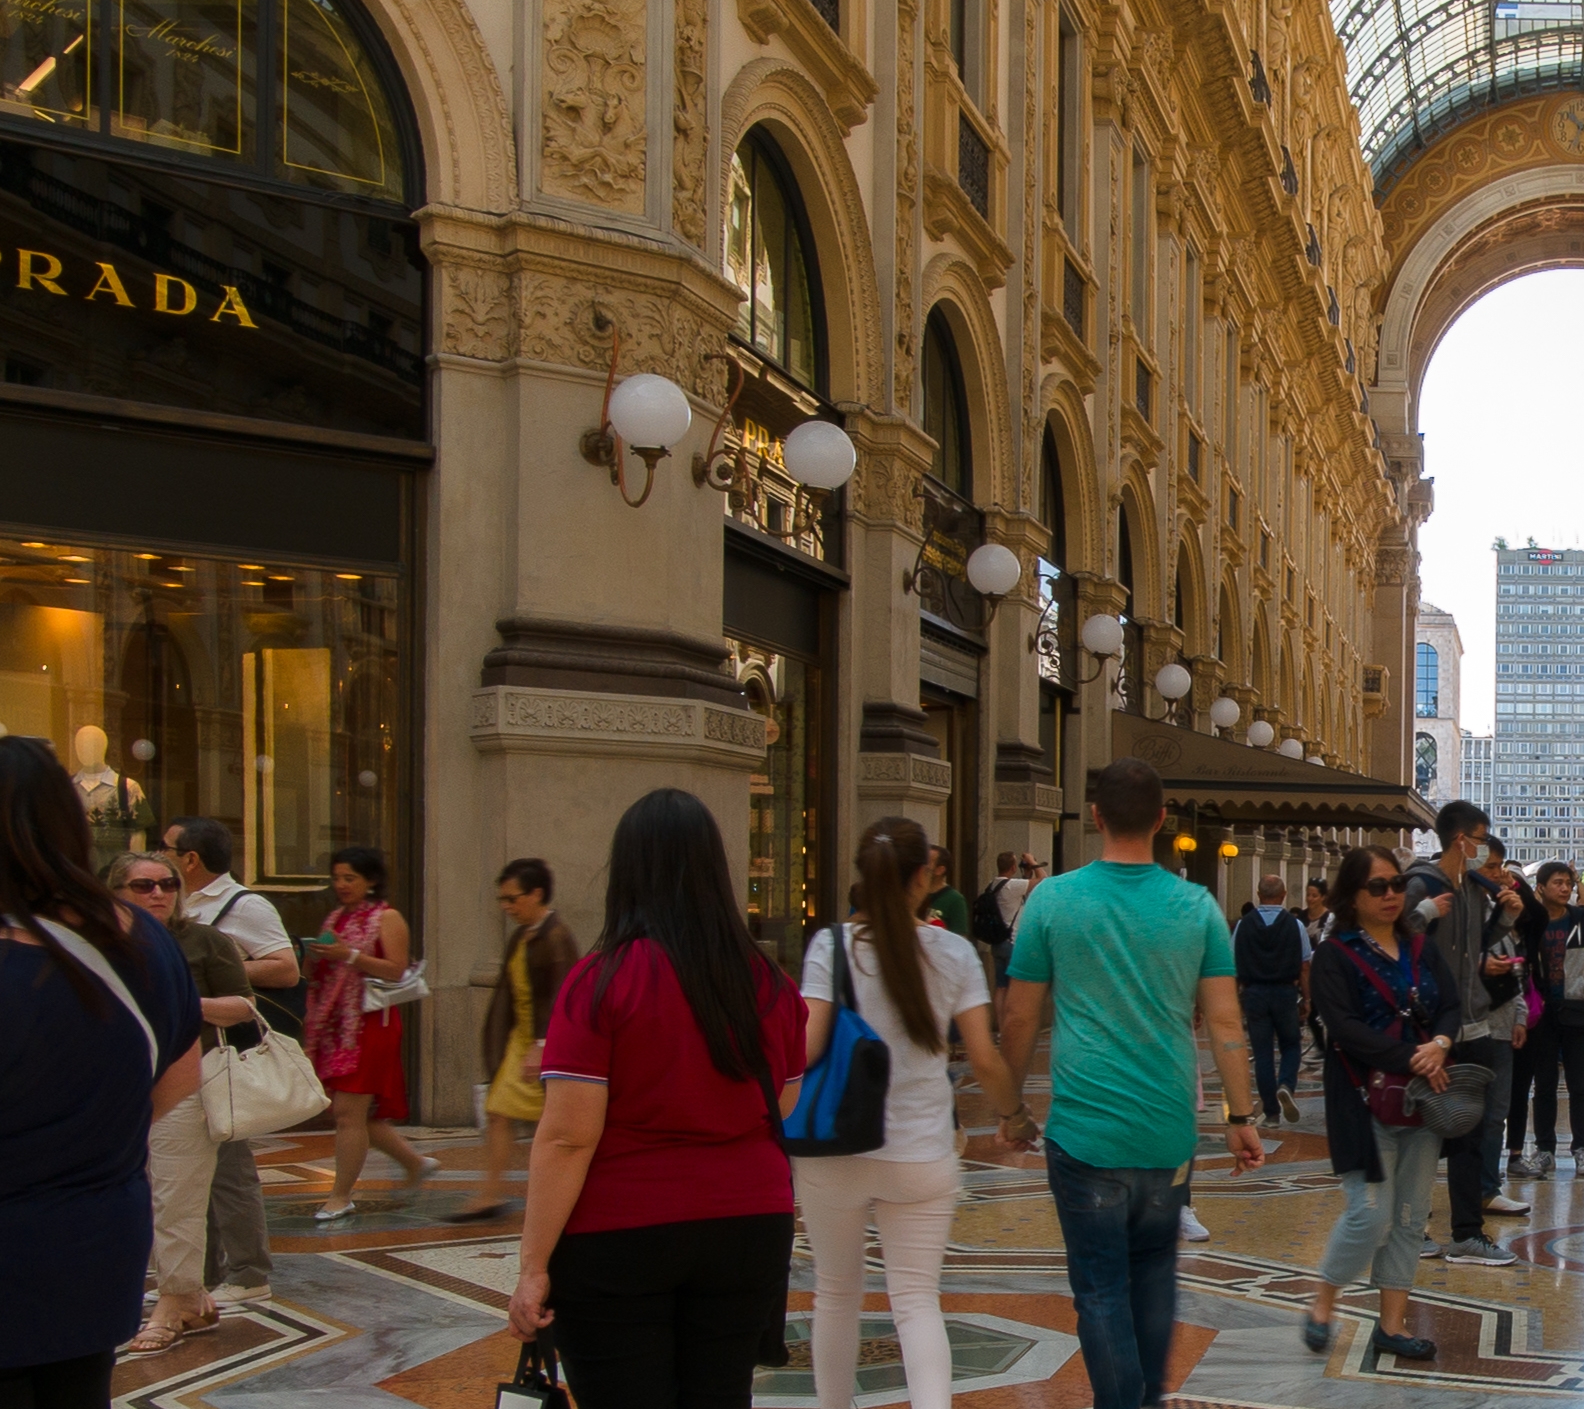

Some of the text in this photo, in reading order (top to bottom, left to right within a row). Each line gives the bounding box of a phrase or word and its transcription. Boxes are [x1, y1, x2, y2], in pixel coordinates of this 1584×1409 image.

[125, 18, 237, 58] Marchesi
[1191, 764, 1289, 778] Bar Ristorante
